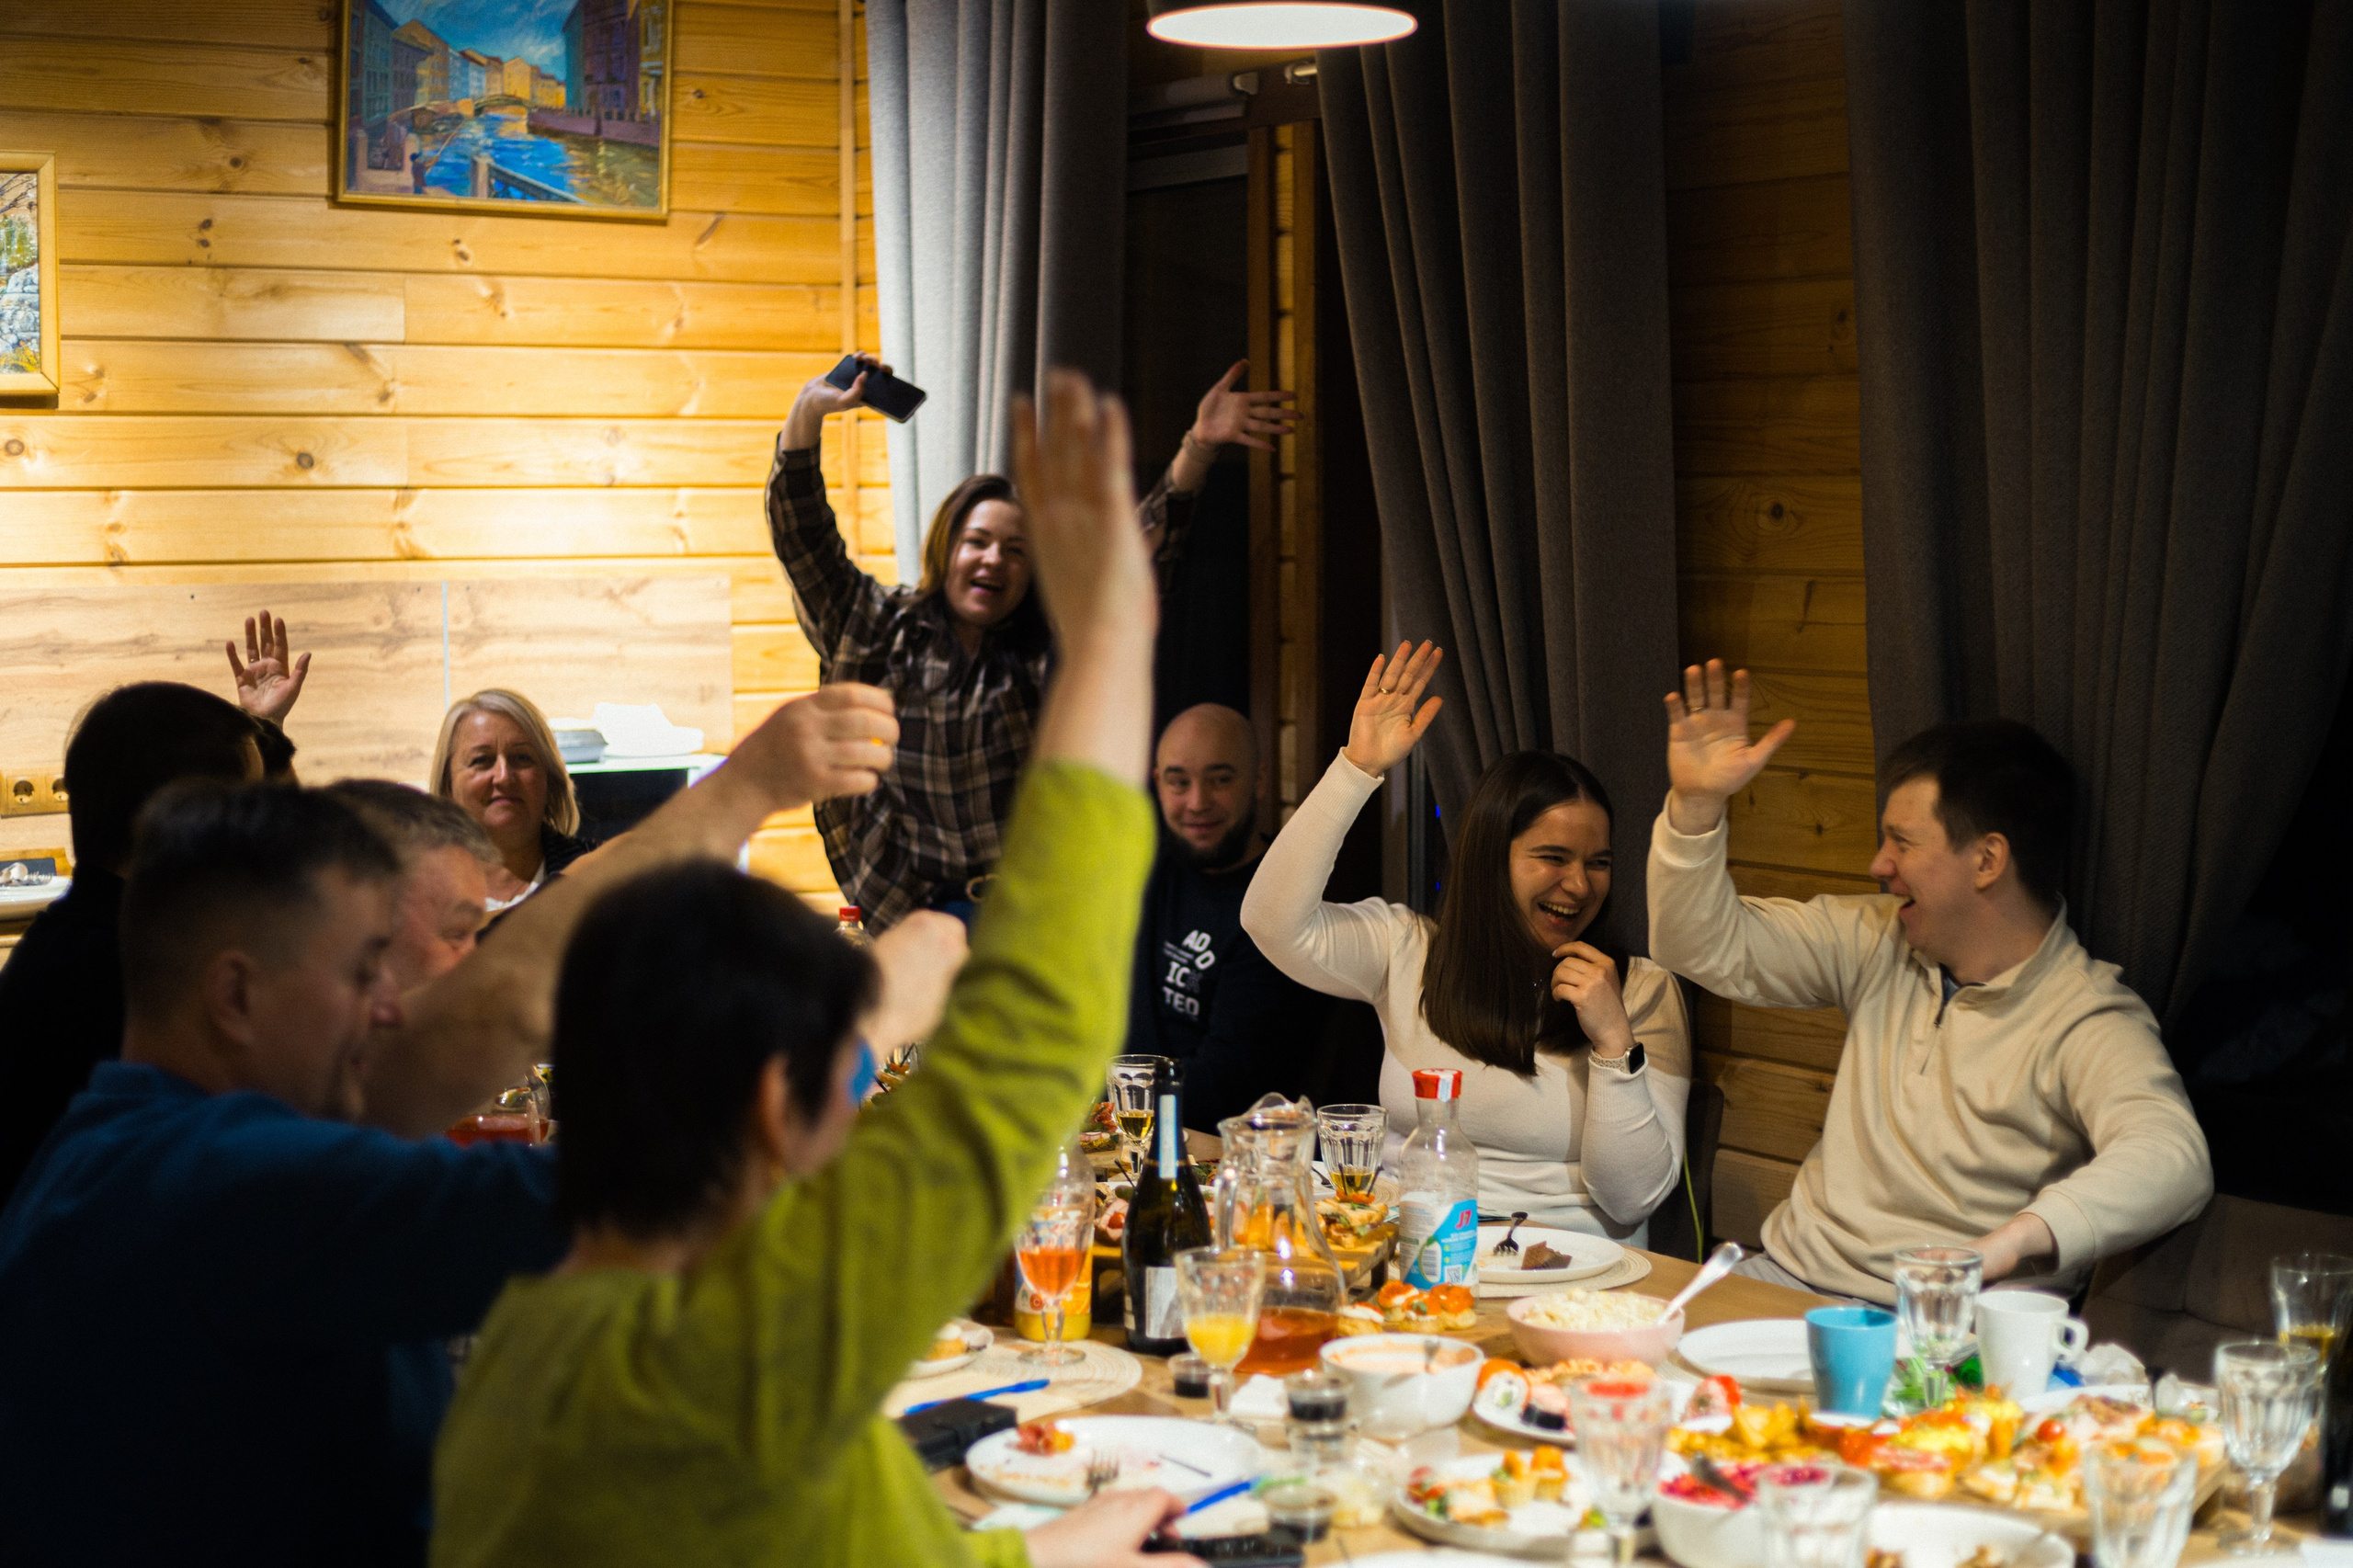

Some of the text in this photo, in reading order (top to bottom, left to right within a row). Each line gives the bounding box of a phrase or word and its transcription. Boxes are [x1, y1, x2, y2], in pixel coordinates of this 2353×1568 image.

[1182, 929, 1211, 952] AD
[1163, 986, 1199, 1017] TED
[1455, 1210, 1472, 1229] J7
